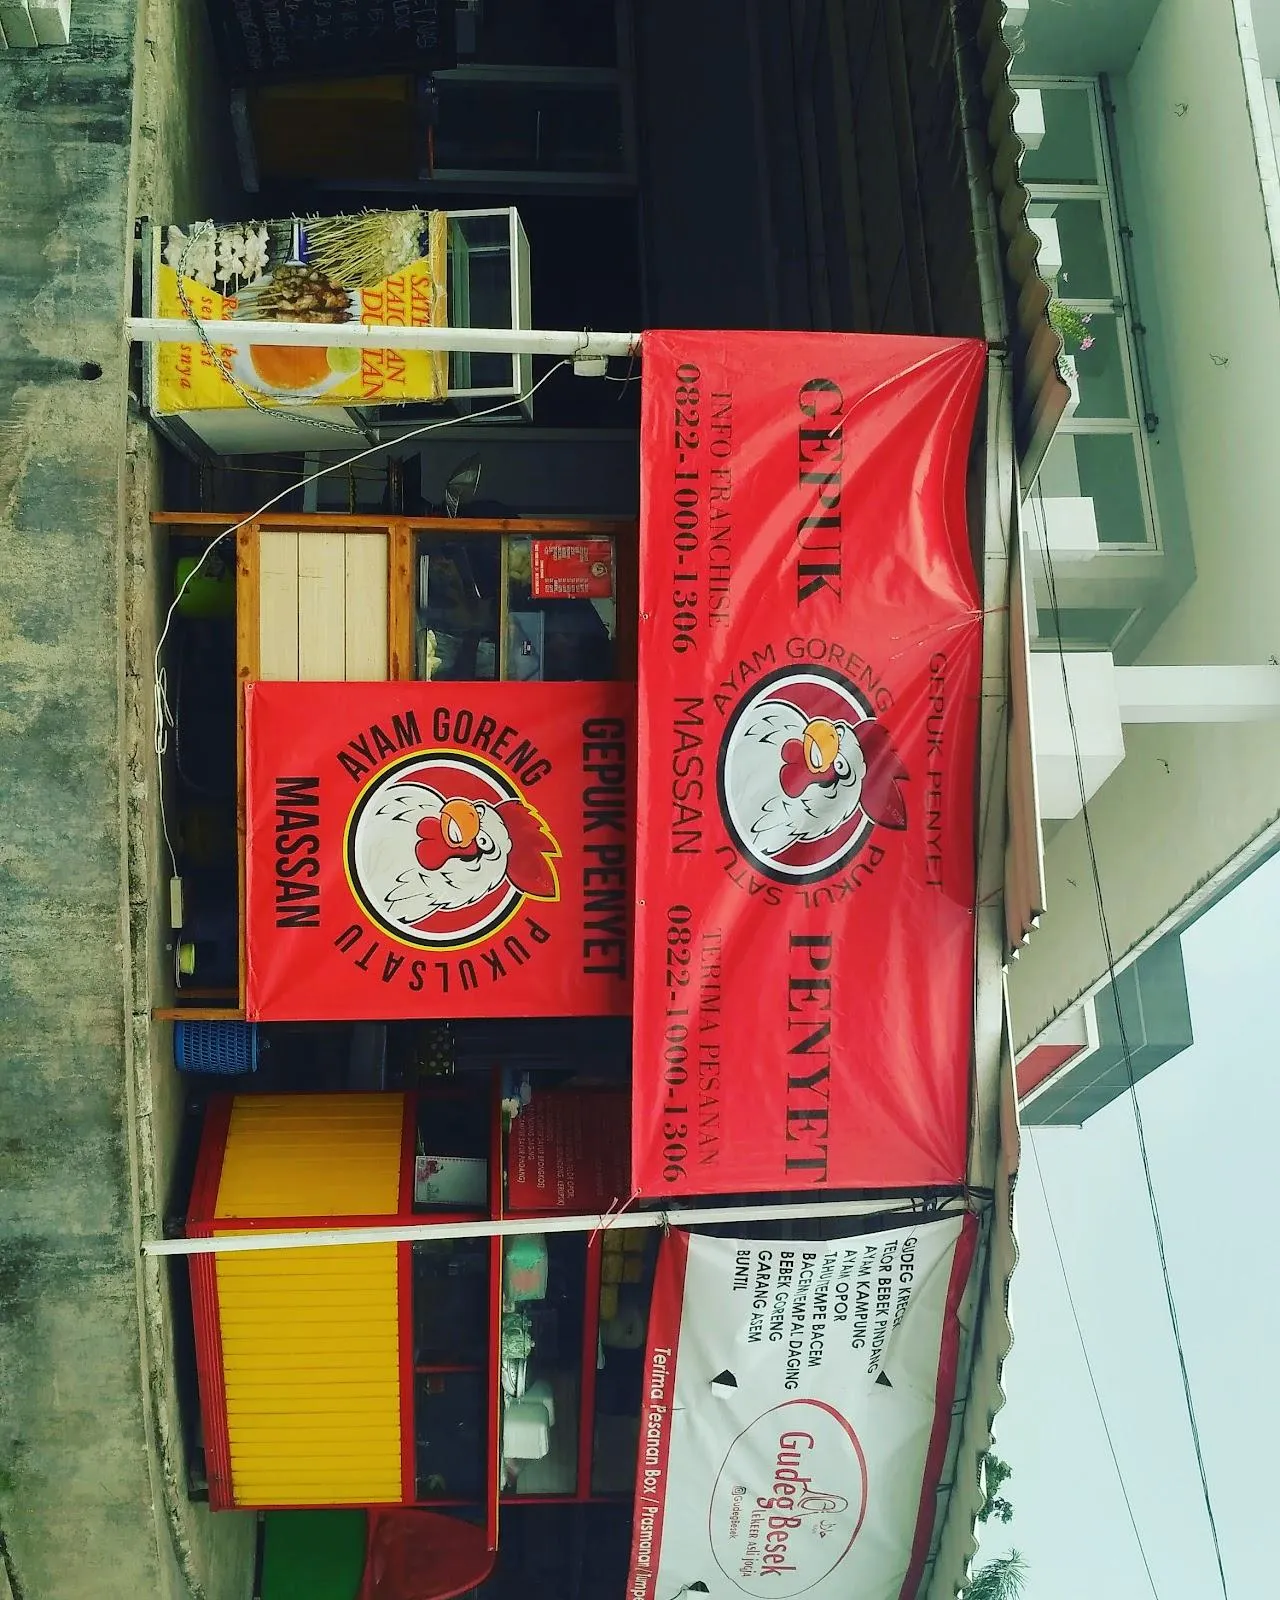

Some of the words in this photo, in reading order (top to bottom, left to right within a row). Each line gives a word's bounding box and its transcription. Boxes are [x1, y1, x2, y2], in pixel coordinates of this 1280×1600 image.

[710, 392, 732, 458] INFO
[672, 363, 701, 654] 0822-1000-1306
[796, 378, 844, 608] GEPUK
[708, 468, 732, 628] FRANCHISE
[712, 644, 777, 716] AYAM
[786, 638, 895, 712] GORENG
[926, 652, 947, 757] GEPUK
[336, 710, 423, 783] AYAM
[432, 707, 552, 787] GORENG
[582, 718, 626, 833] GEPUK
[672, 698, 704, 854] MASSAN
[275, 777, 320, 928] MASSAN
[926, 771, 944, 894] PENYET
[716, 845, 782, 906] SATU
[796, 844, 886, 909] PUKUL
[582, 844, 626, 980] PENYET
[698, 928, 722, 1033] TERIMA
[662, 905, 692, 1182] 0822-1000-1306
[785, 930, 832, 1183] PENYET
[698, 1043, 720, 1166] PESANAN
[733, 1250, 750, 1291] BUNTIL
[752, 1250, 772, 1310] GARANG
[776, 1252, 794, 1289] BEBEK
[838, 1250, 858, 1280] AYAM
[858, 1246, 878, 1276] AYAM
[878, 1240, 898, 1272] TELOR
[899, 1238, 918, 1283] GUDEG
[768, 1292, 789, 1342] GORENG
[834, 1282, 849, 1322] OPOR
[852, 1281, 870, 1349] KAMPUNG
[876, 1278, 892, 1316] BEBEK
[748, 1312, 764, 1344] ASEM
[808, 1324, 826, 1368] BACEM
[867, 1320, 888, 1374] PINDANG
[650, 1348, 671, 1399] Terima
[784, 1340, 802, 1390] DAGING
[644, 1405, 667, 1465] Pesanan
[643, 1470, 661, 1494] Box
[756, 1432, 814, 1510] Gudeg
[638, 1507, 658, 1567] Prasmanan
[760, 1516, 802, 1576] Besek
